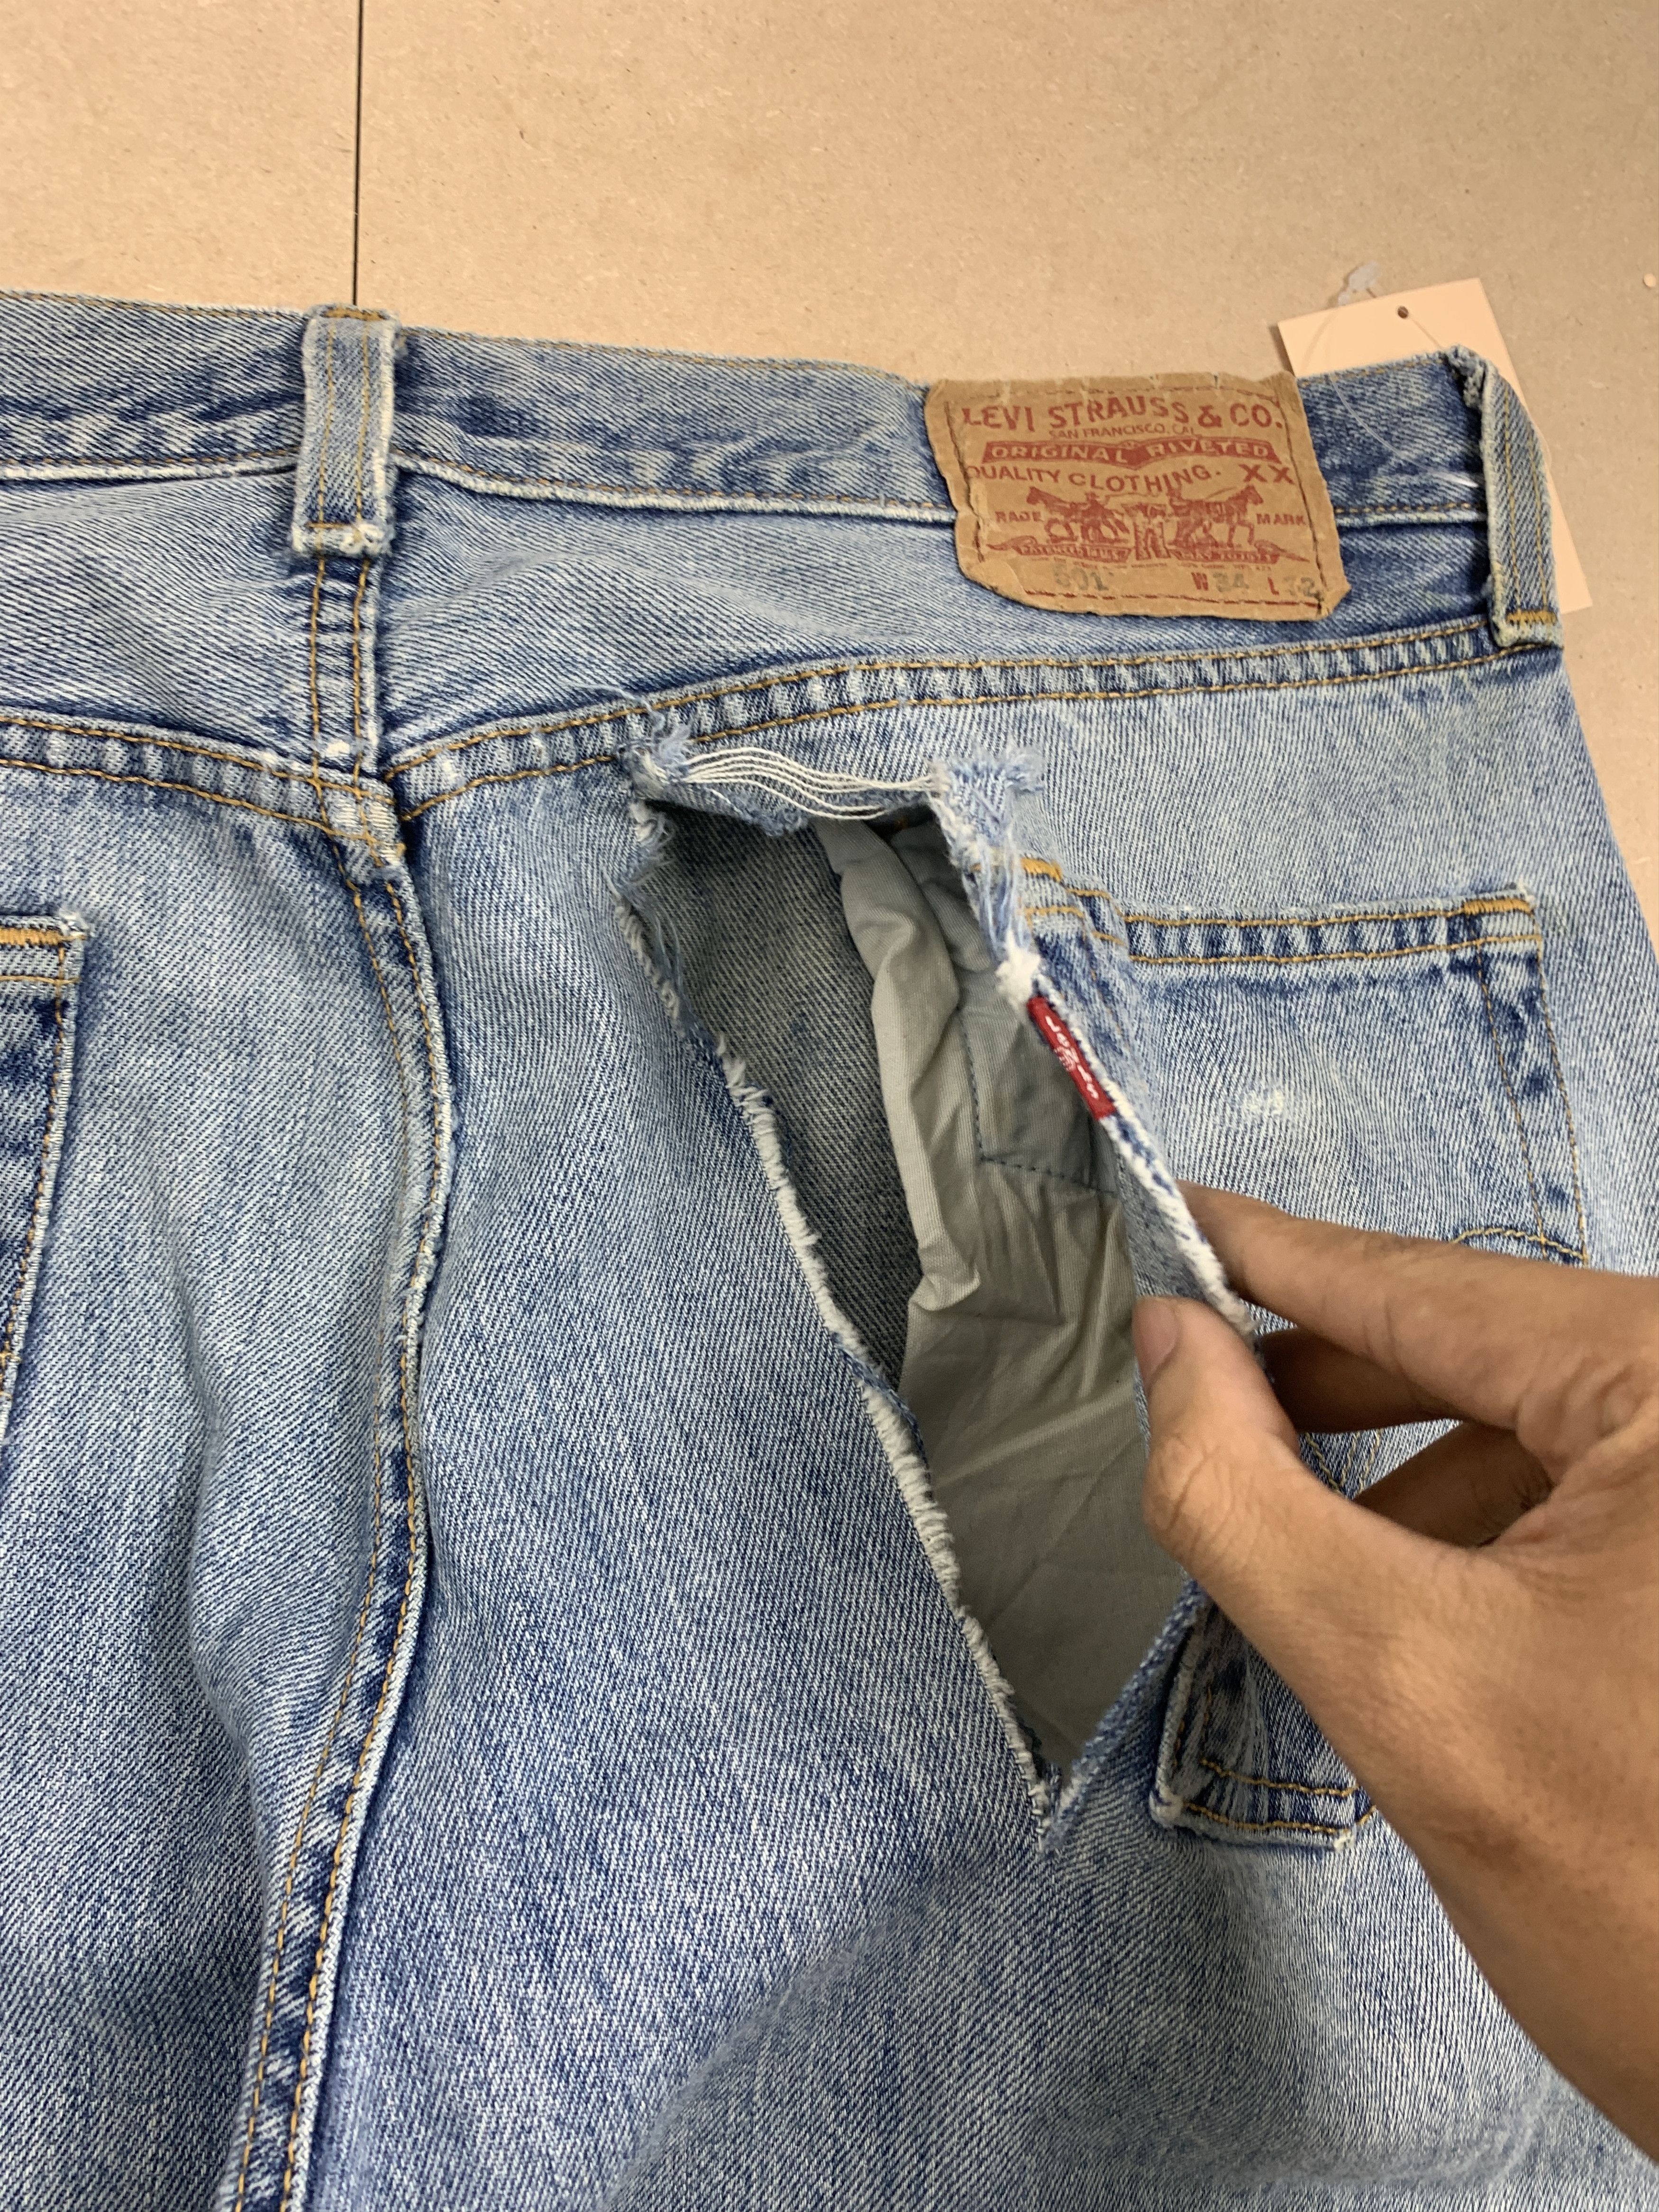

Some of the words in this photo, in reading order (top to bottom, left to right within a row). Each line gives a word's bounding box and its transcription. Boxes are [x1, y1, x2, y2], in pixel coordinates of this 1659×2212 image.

[962, 406, 1035, 433] LEVI
[1048, 396, 1189, 428] STRAUSS
[1198, 405, 1222, 428] &
[1230, 403, 1283, 429] CO.
[1049, 429, 1078, 439] SAN
[992, 446, 1128, 464] ORIGINAL
[1145, 440, 1269, 457] RIVETED
[967, 465, 1060, 483] QUALITY
[1257, 513, 1306, 525] MARK
[1267, 576, 1280, 596] L
